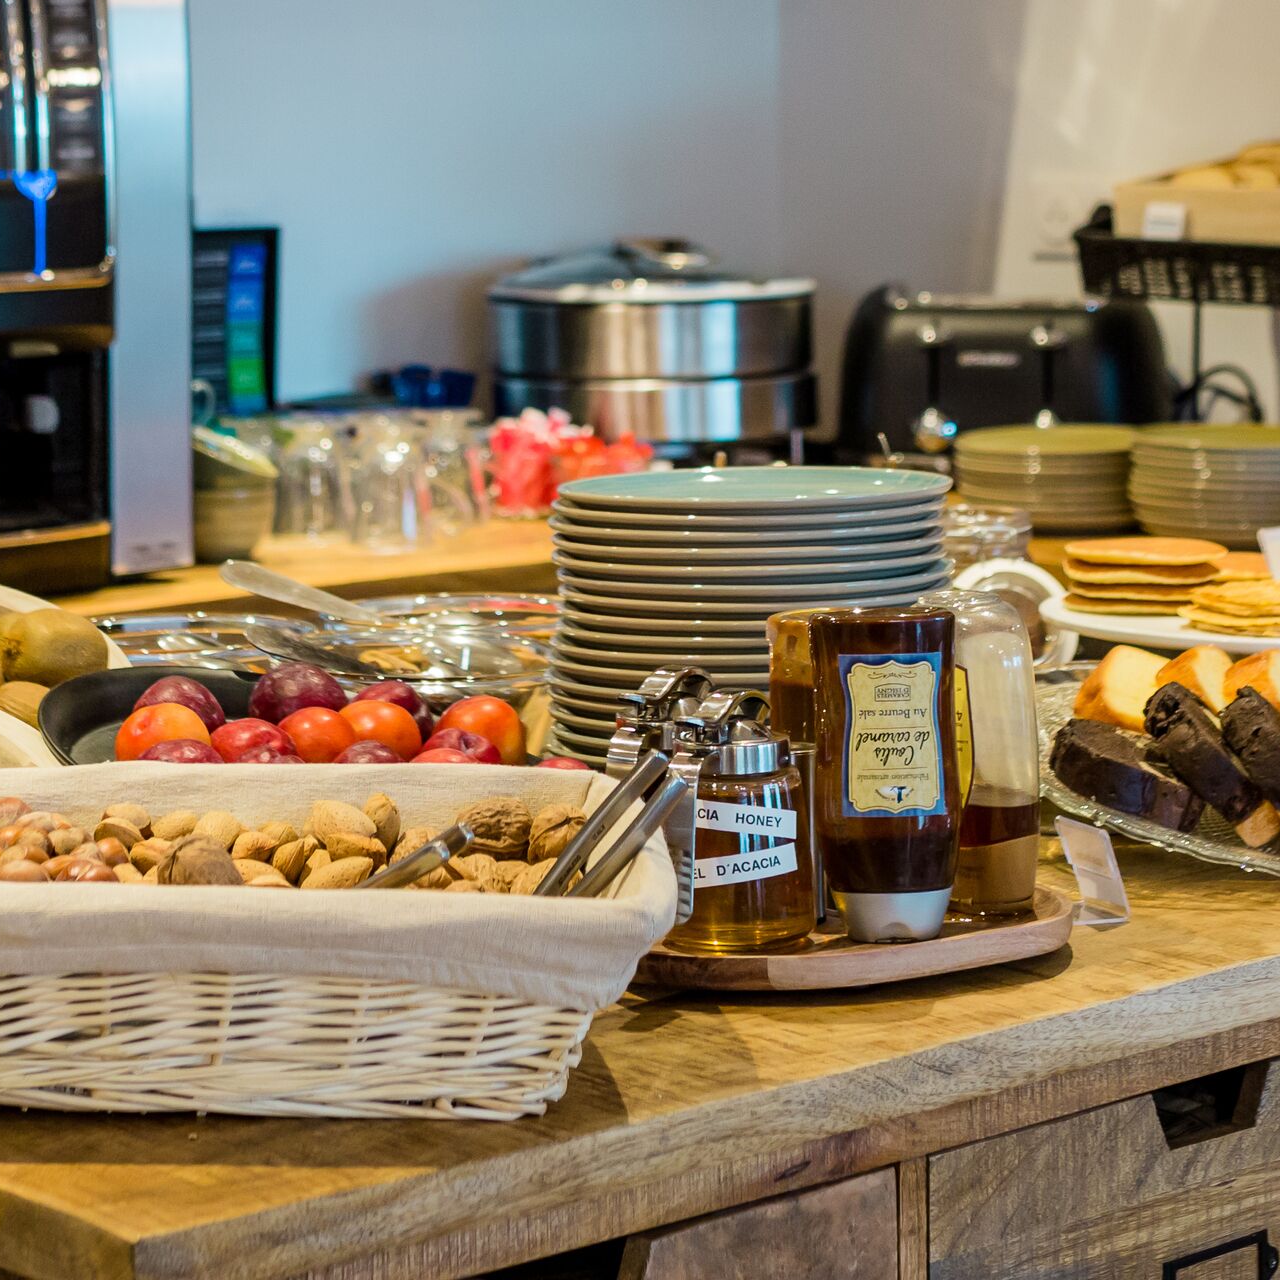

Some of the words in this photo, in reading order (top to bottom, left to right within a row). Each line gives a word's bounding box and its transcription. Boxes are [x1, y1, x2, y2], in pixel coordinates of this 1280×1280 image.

[858, 709, 876, 720] salé
[879, 708, 910, 719] Beurre
[913, 708, 928, 718] Au
[855, 731, 911, 752] caramel
[913, 730, 930, 750] de
[873, 745, 915, 767] Coulis
[856, 773, 890, 782] artisanale
[891, 773, 929, 781] Fabrication
[696, 808, 719, 821] CIA
[735, 812, 782, 828] HONEY
[716, 855, 781, 876] D'ACACIA
